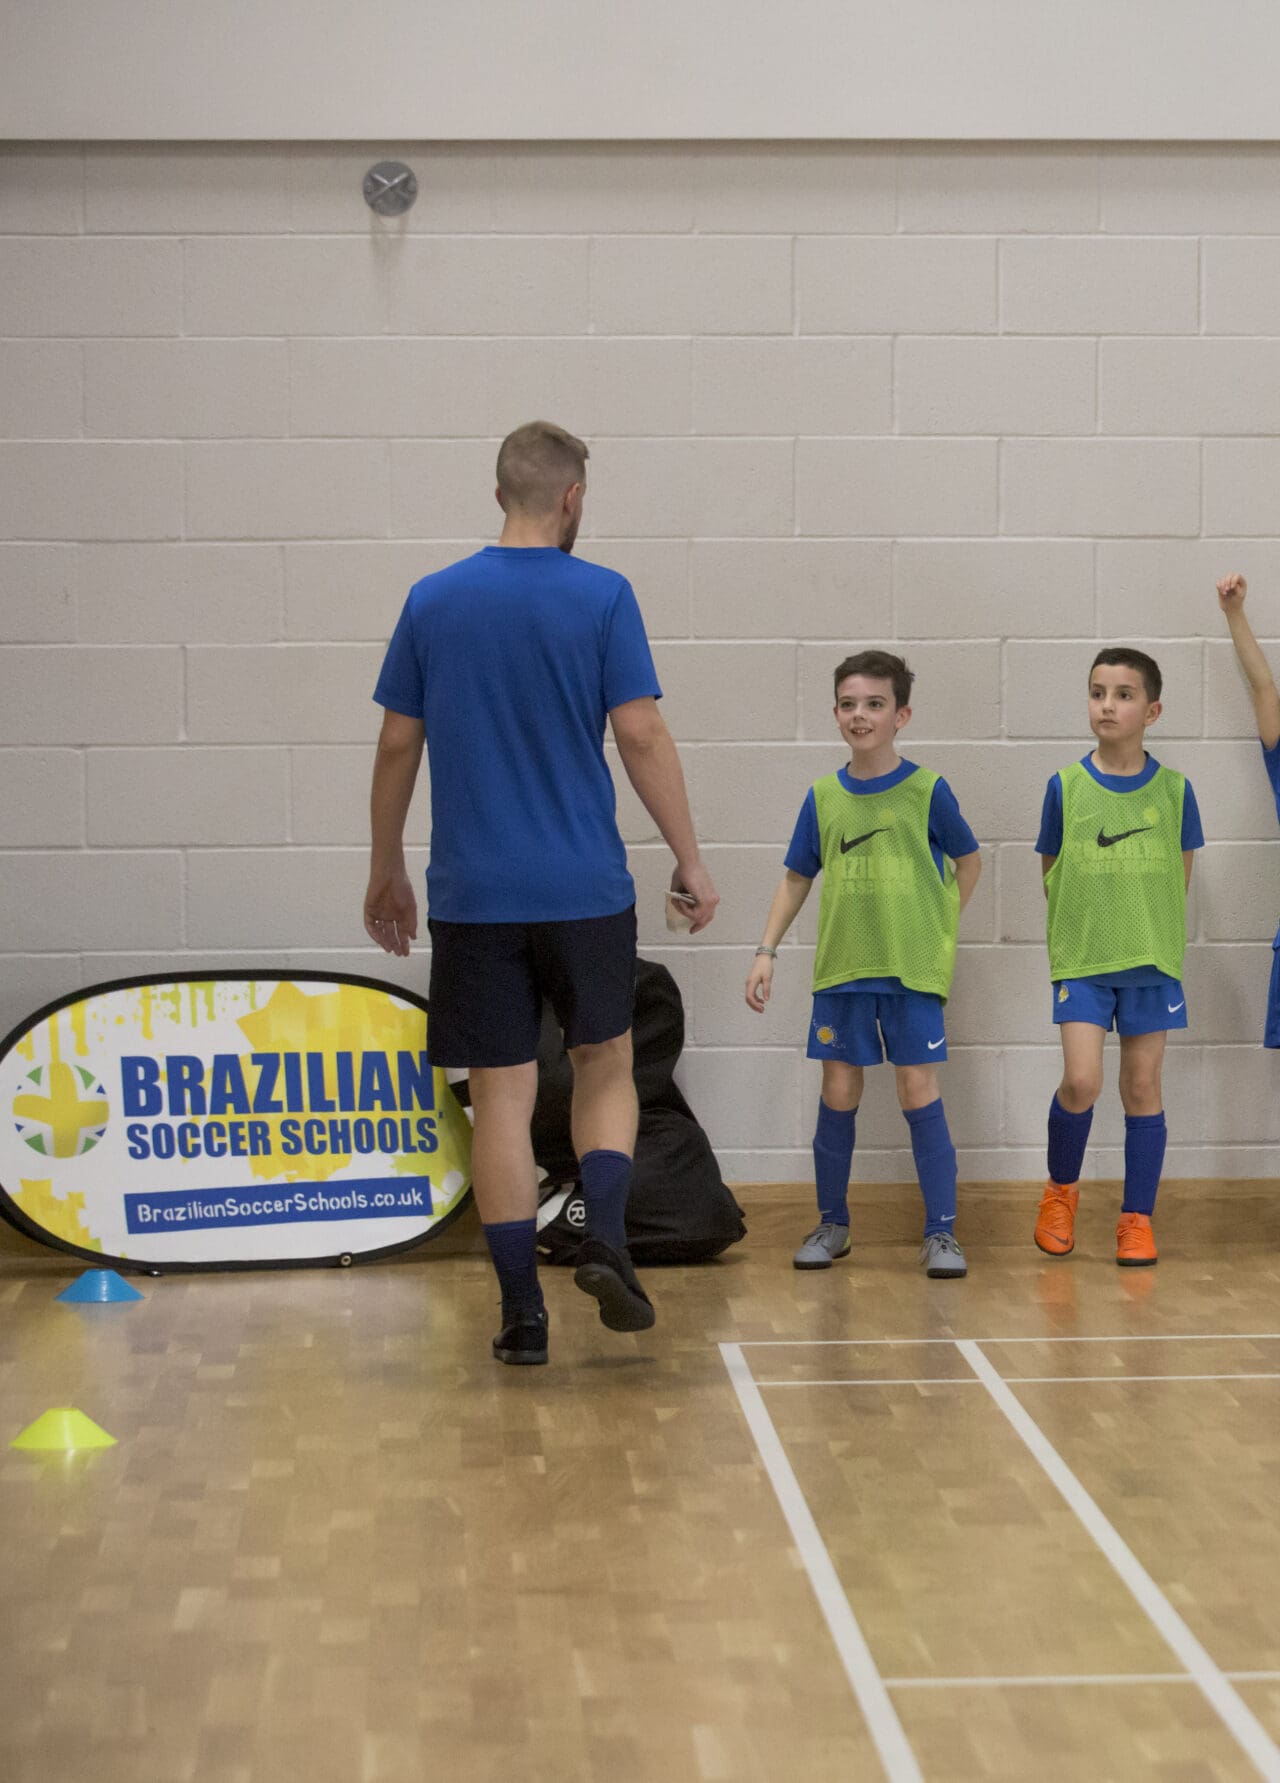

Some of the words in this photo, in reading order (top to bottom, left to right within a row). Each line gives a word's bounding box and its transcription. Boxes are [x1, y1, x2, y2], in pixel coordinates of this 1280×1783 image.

[121, 1051, 435, 1117] BRAZILIAN
[127, 1121, 272, 1160] SOCCER
[280, 1117, 439, 1155] SCHOOLS
[137, 1187, 424, 1223] BrazilianSoccerSchools.co.uk
